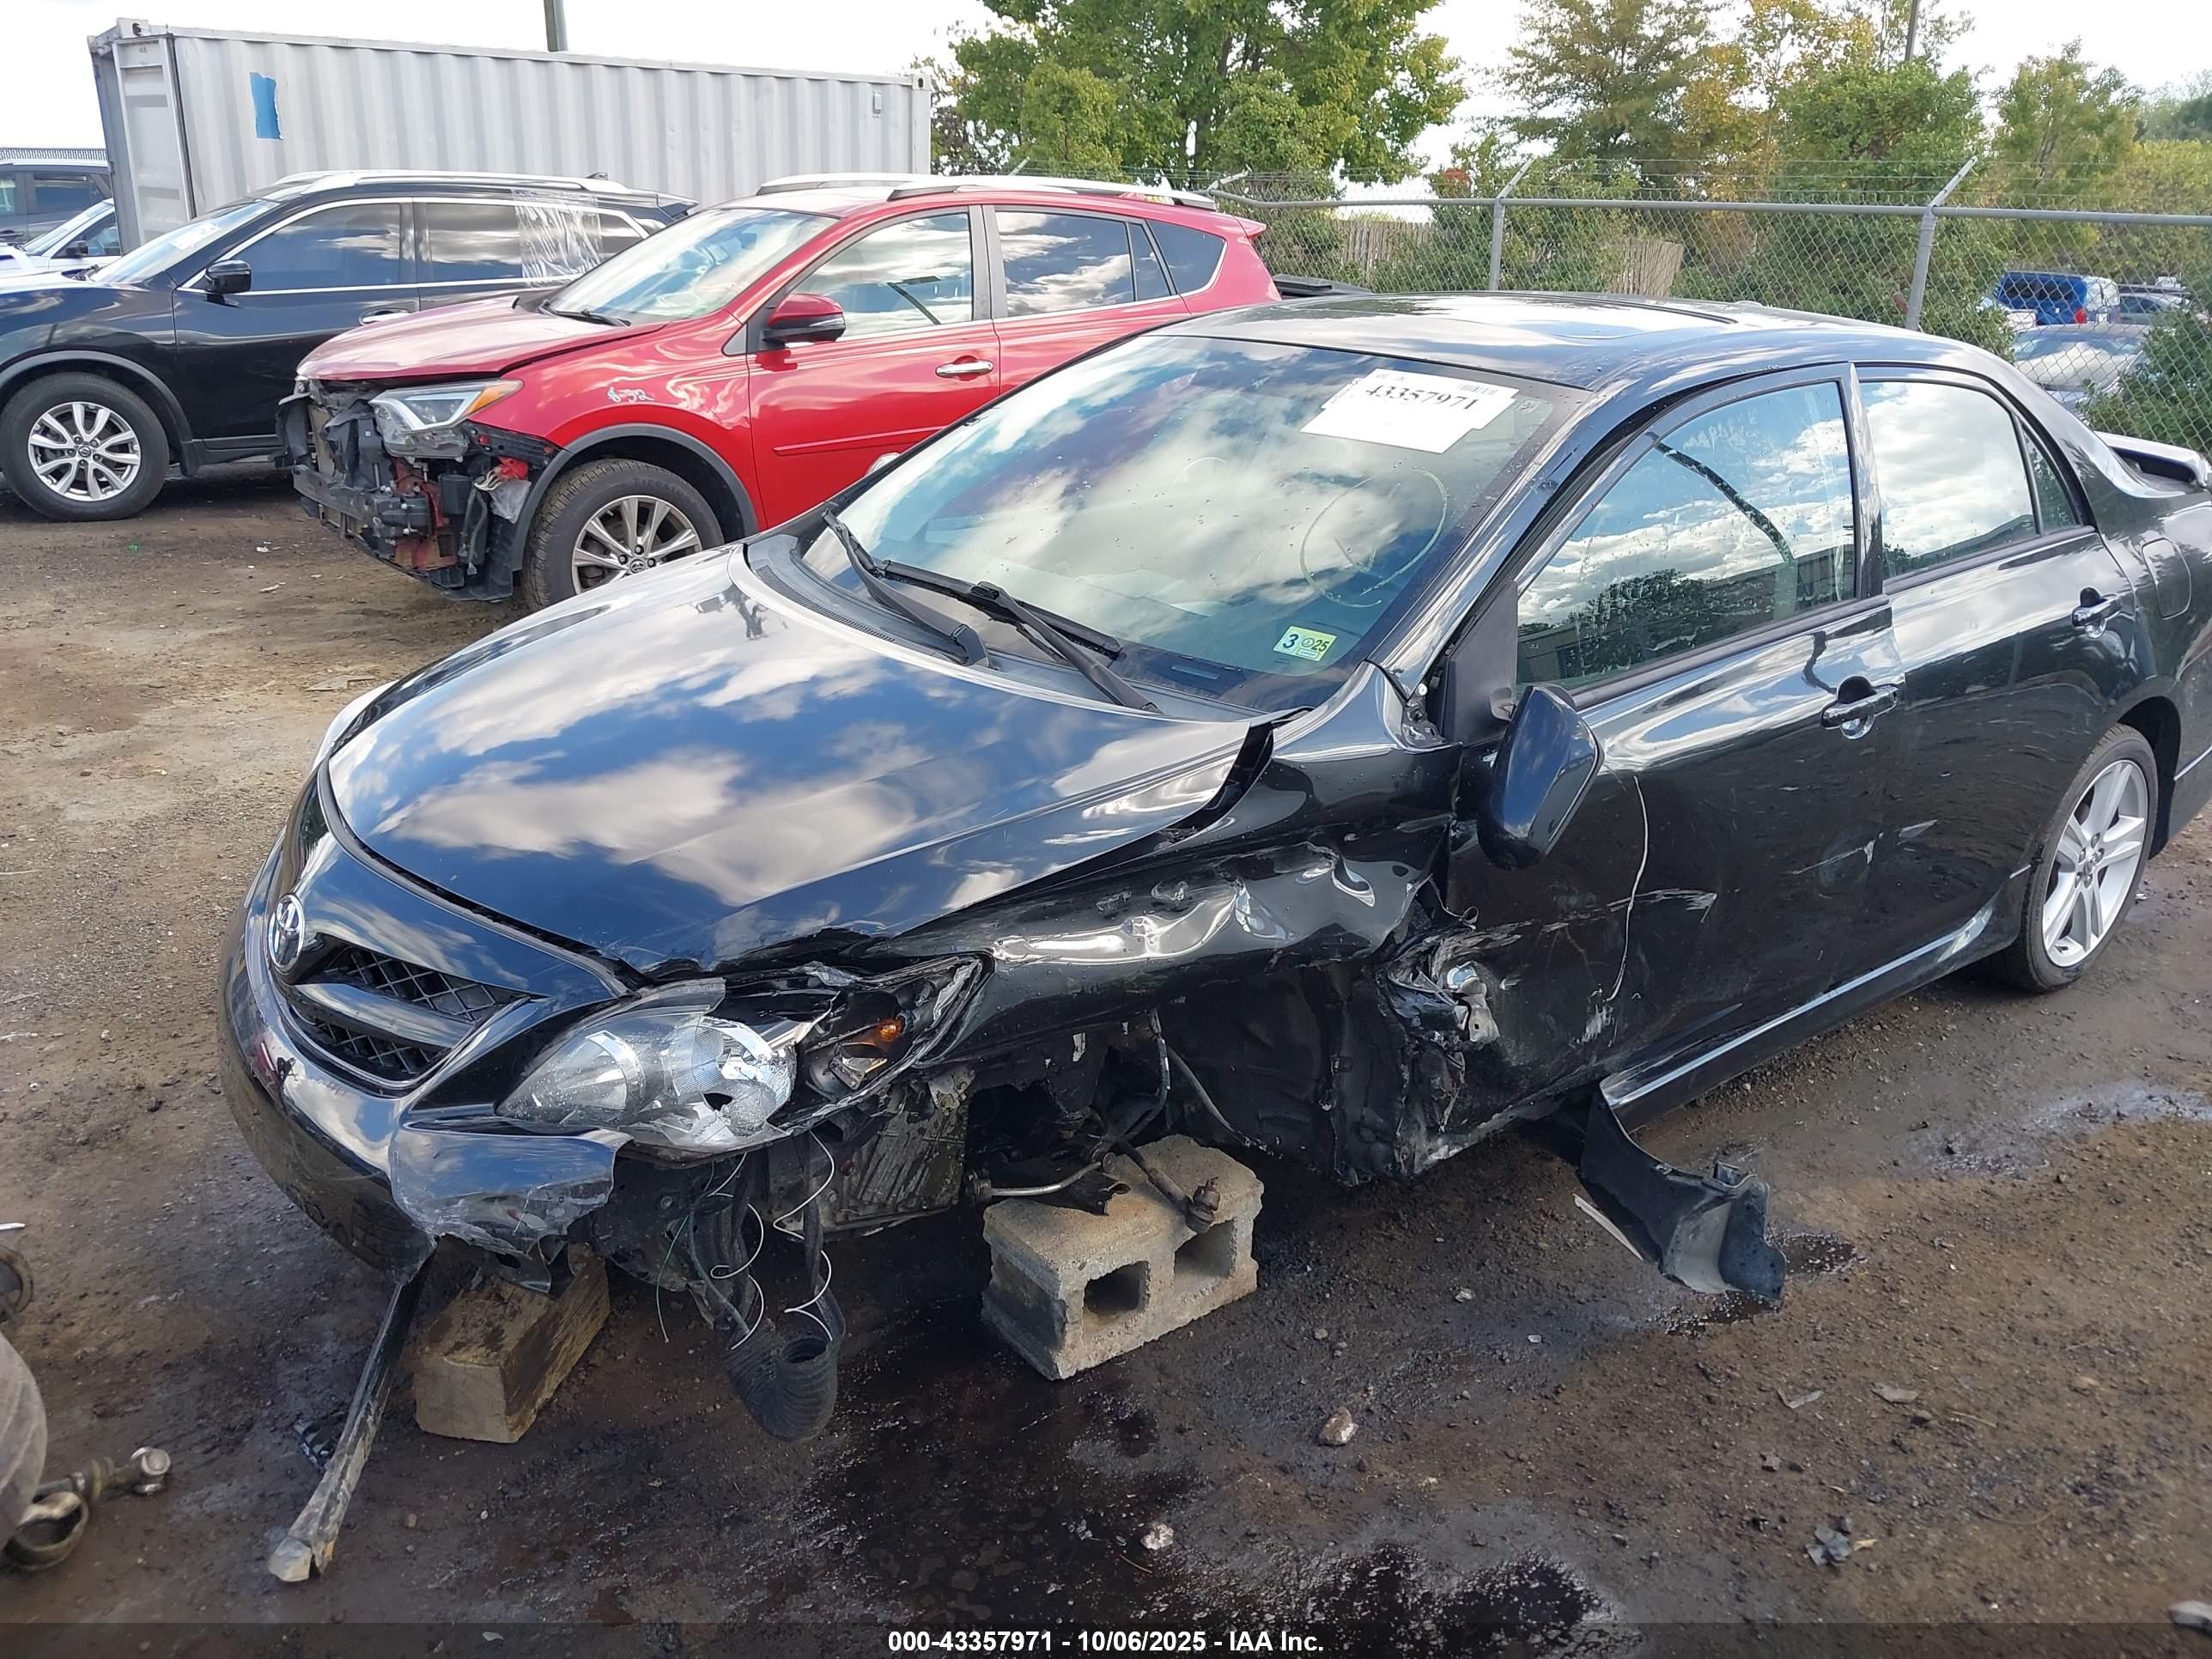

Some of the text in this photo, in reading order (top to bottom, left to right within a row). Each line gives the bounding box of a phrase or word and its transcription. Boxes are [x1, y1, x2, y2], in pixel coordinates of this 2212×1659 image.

[1365, 384, 1479, 410] 43357971
[1283, 634, 1330, 652] 3 25
